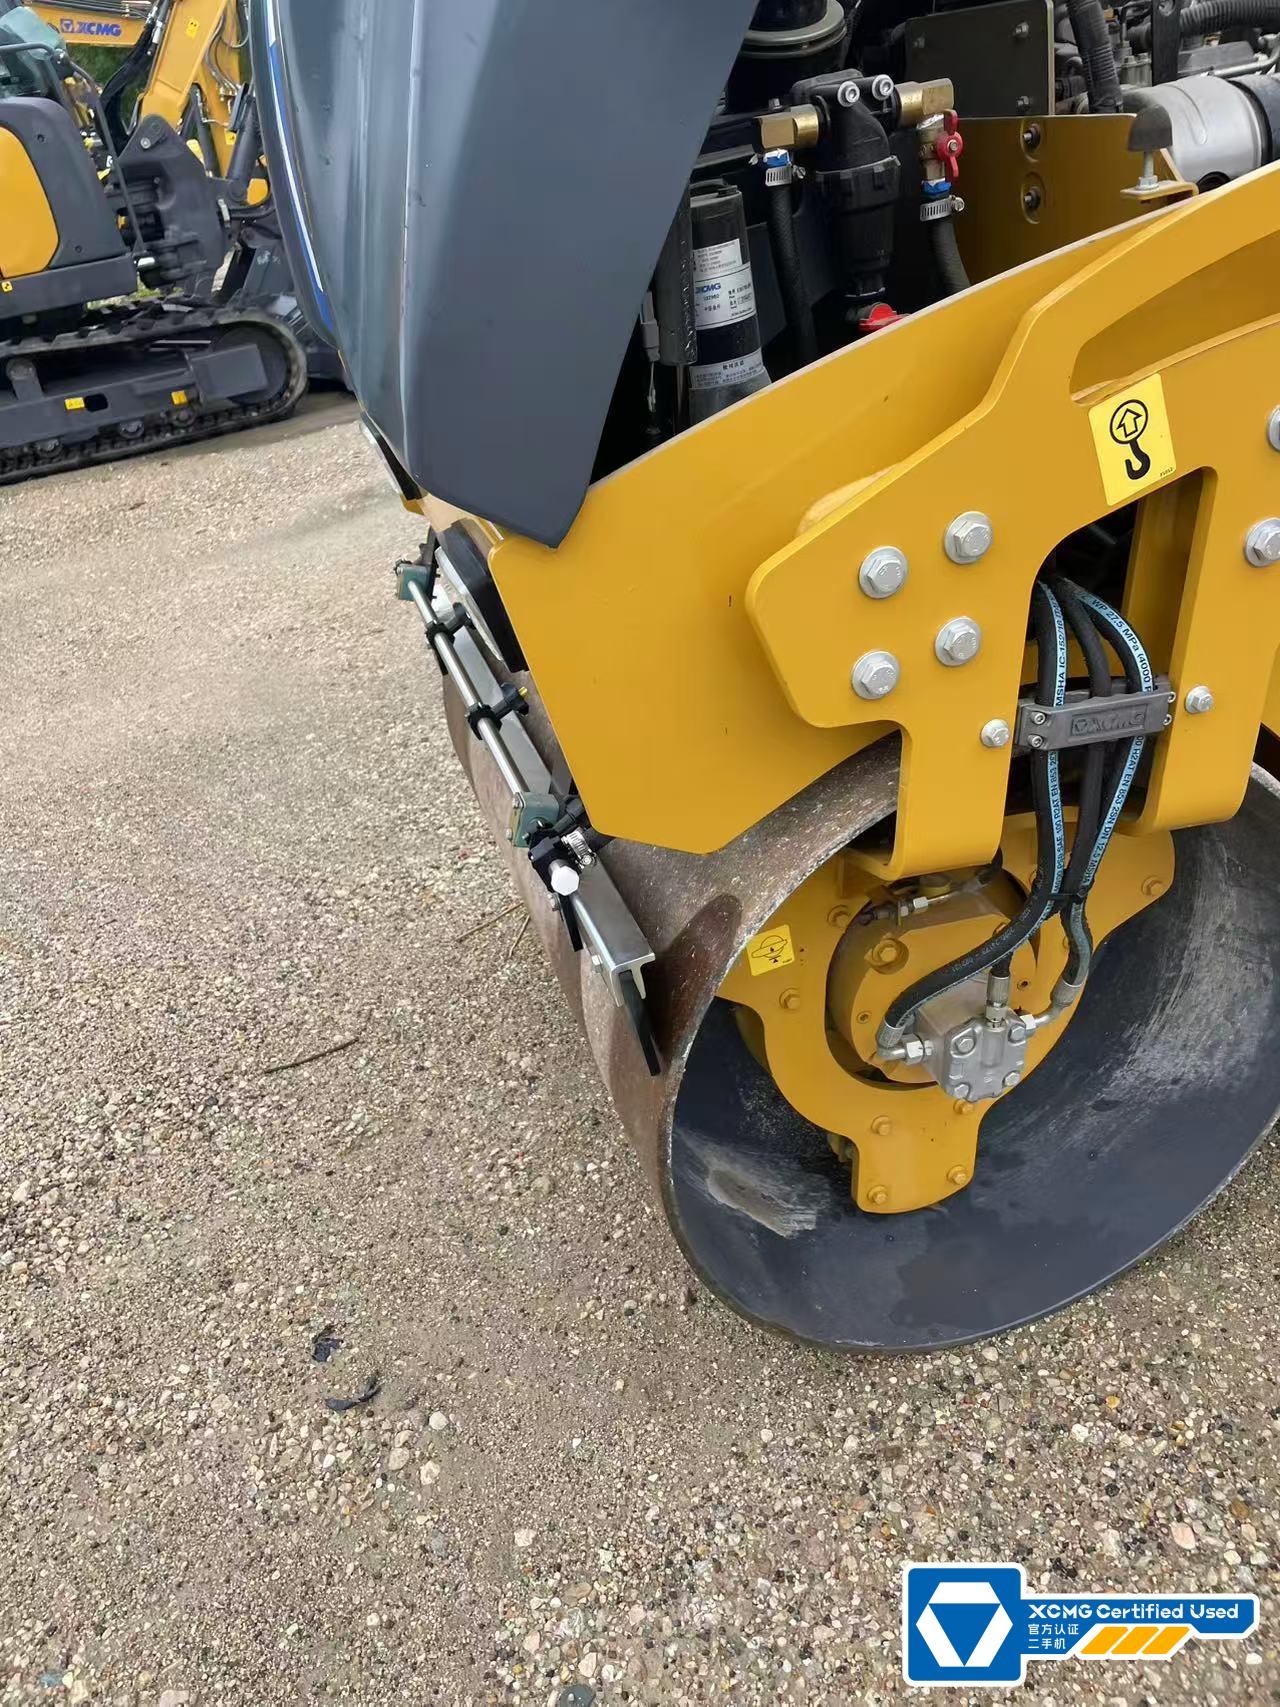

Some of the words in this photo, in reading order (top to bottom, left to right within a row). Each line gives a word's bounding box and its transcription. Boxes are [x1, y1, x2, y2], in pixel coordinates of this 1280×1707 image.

[77, 21, 122, 37] XCMG
[1091, 600, 1108, 611] WP
[1106, 611, 1125, 628] 27.5
[1122, 628, 1139, 651] MPa
[1137, 653, 1151, 683] (4000
[1055, 671, 1065, 706] MSHA
[1121, 773, 1132, 786] EN
[1099, 826, 1112, 841] DN
